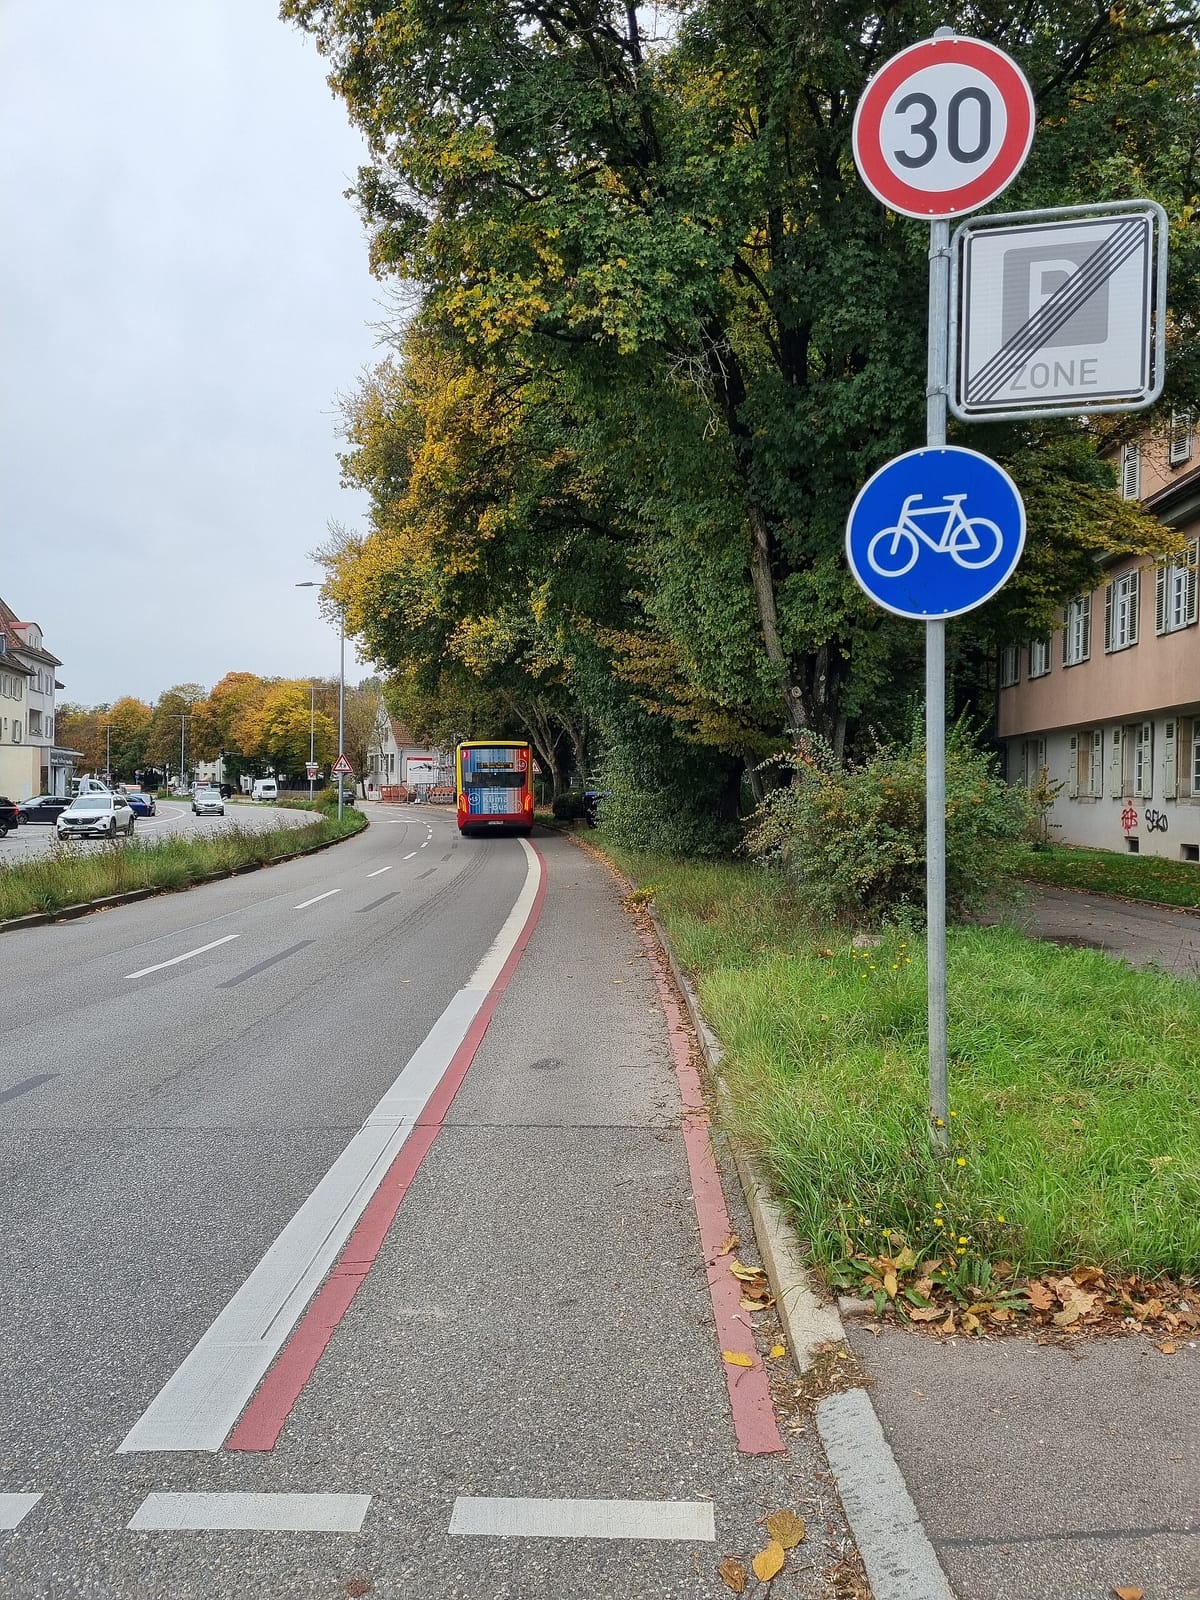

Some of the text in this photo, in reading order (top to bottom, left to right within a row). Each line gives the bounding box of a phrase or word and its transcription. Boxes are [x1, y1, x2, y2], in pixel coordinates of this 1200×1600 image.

[894, 86, 992, 169] 30
[1028, 259, 1083, 337] P
[1010, 358, 1098, 391] ZONE
